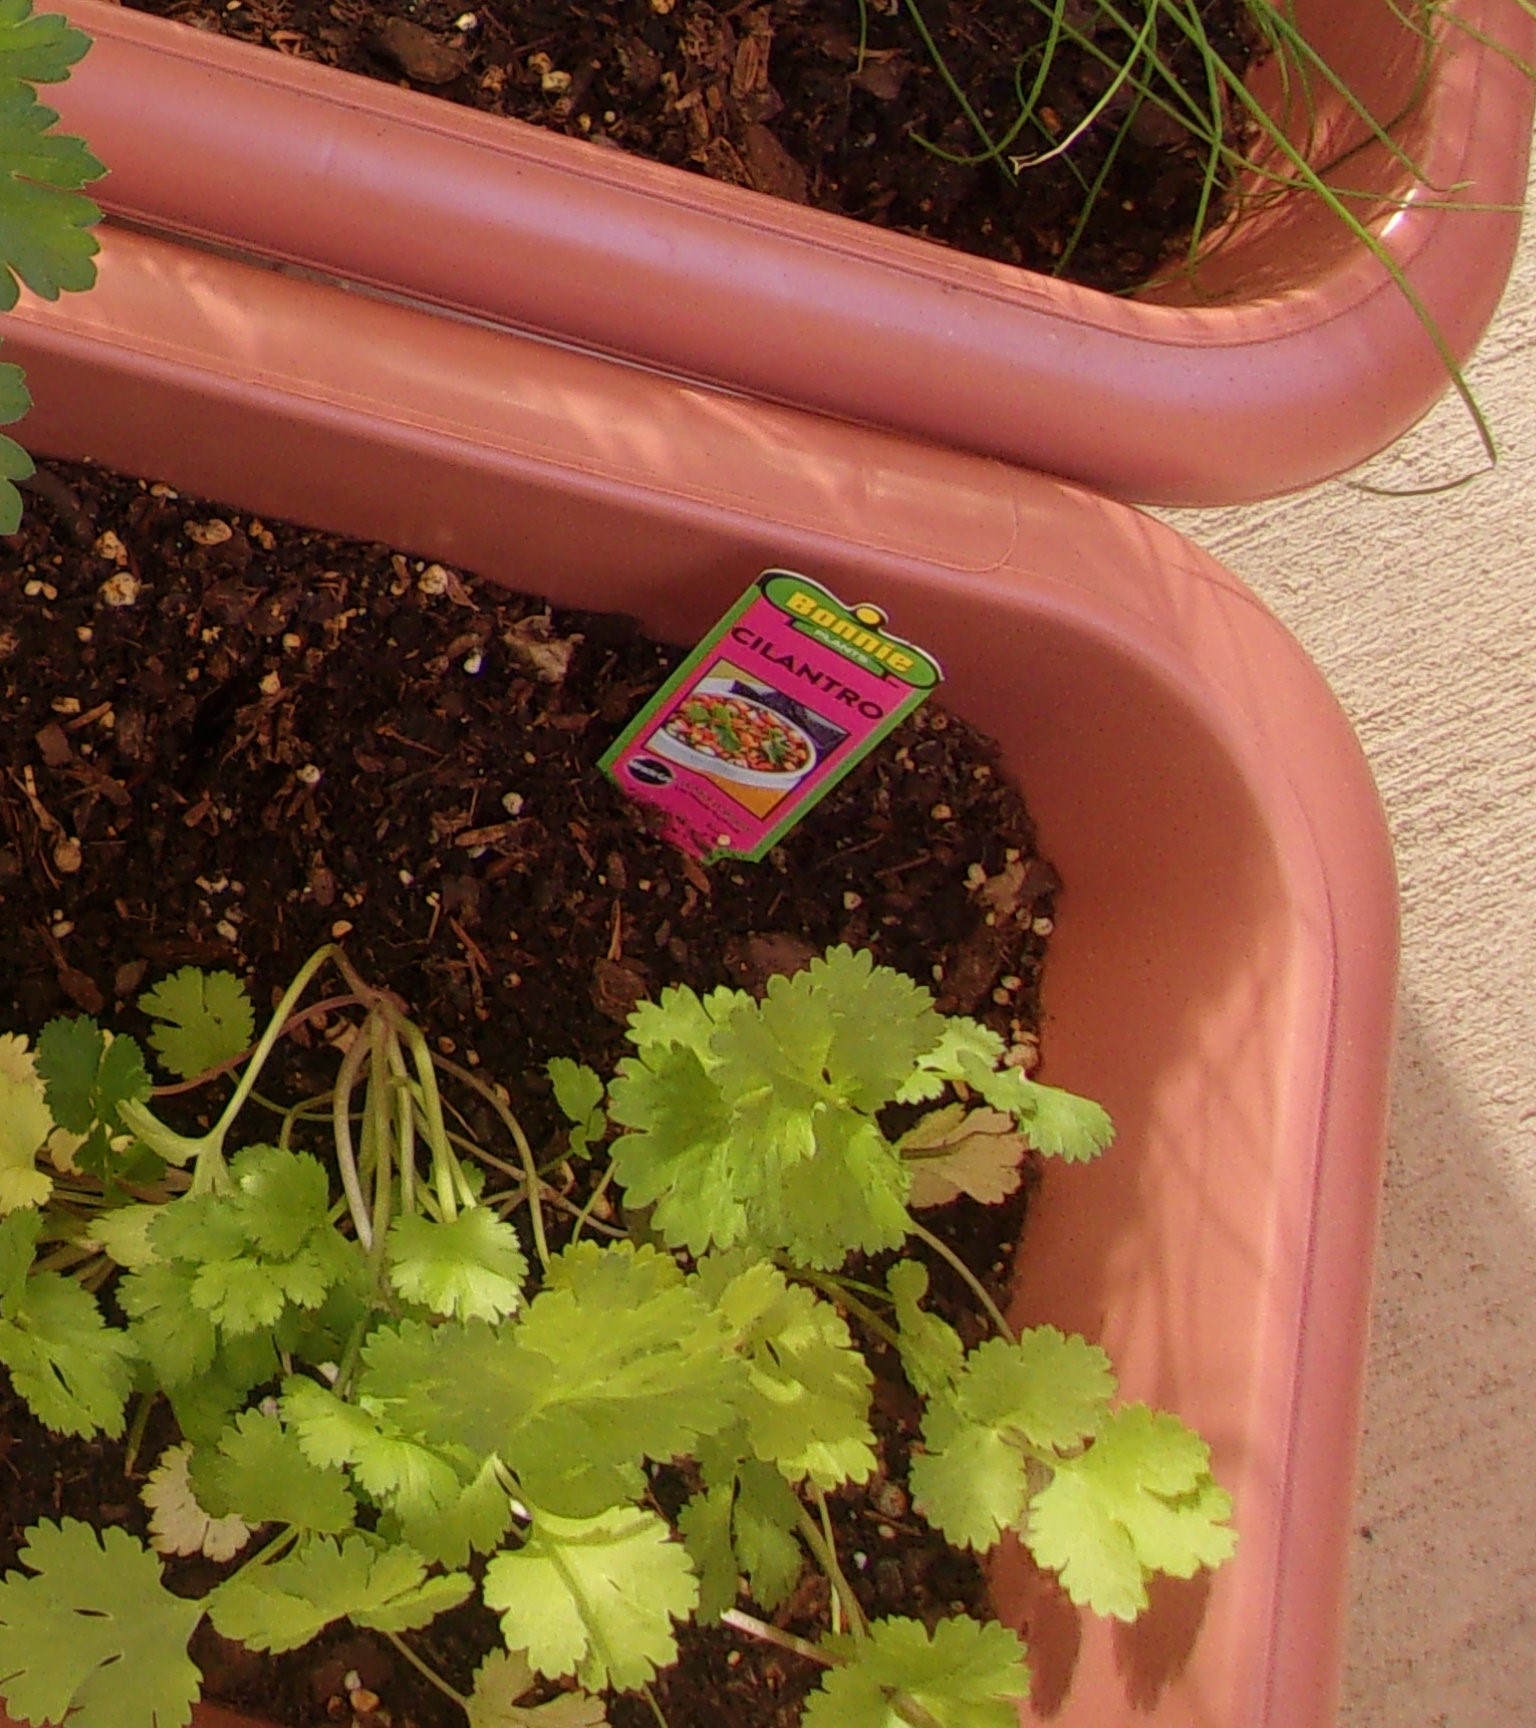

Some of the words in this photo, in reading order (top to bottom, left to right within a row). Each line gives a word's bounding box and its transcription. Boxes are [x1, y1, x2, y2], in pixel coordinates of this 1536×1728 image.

[731, 626, 885, 721] CILANTRO
[785, 590, 916, 674] Bonnie
[813, 628, 870, 665] PLANTS
